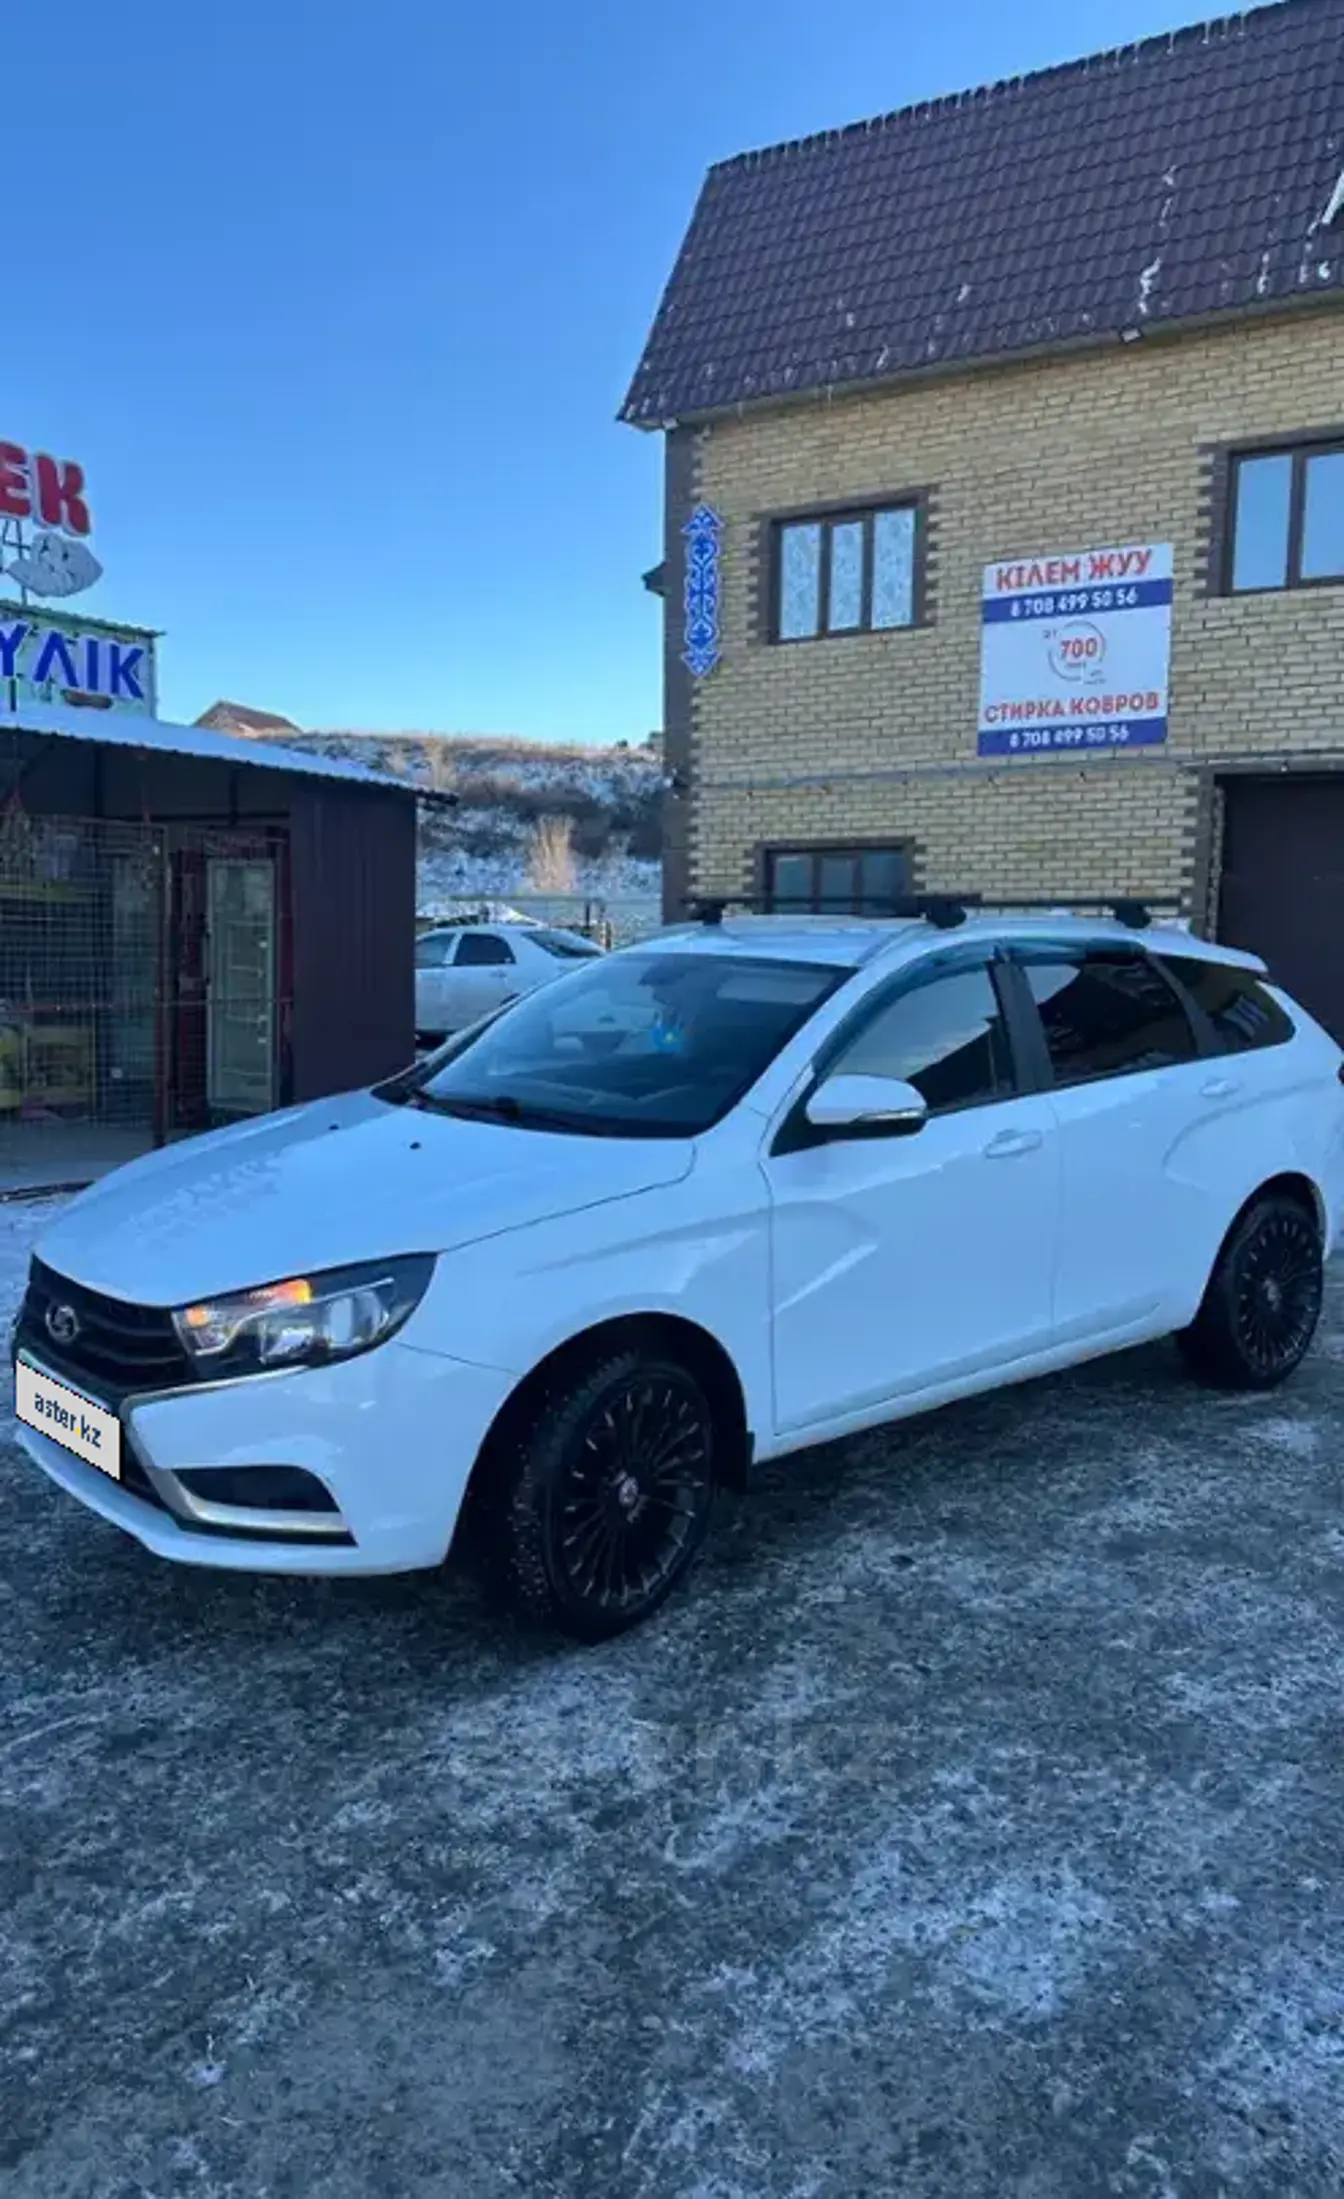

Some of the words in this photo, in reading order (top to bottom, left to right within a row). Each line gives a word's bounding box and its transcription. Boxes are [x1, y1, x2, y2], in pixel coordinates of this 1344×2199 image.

[996, 559, 1080, 591] КІЛЕМ
[1089, 549, 1152, 579] ЖУУ
[1024, 597, 1054, 616] 708
[1058, 592, 1088, 612] 499
[1091, 590, 1112, 608] 50
[1116, 586, 1138, 605] 56
[1060, 637, 1098, 660] 700
[984, 700, 1065, 723] СТИРКА
[1070, 691, 1160, 716] КОВРОВ
[1109, 723, 1130, 741] 56
